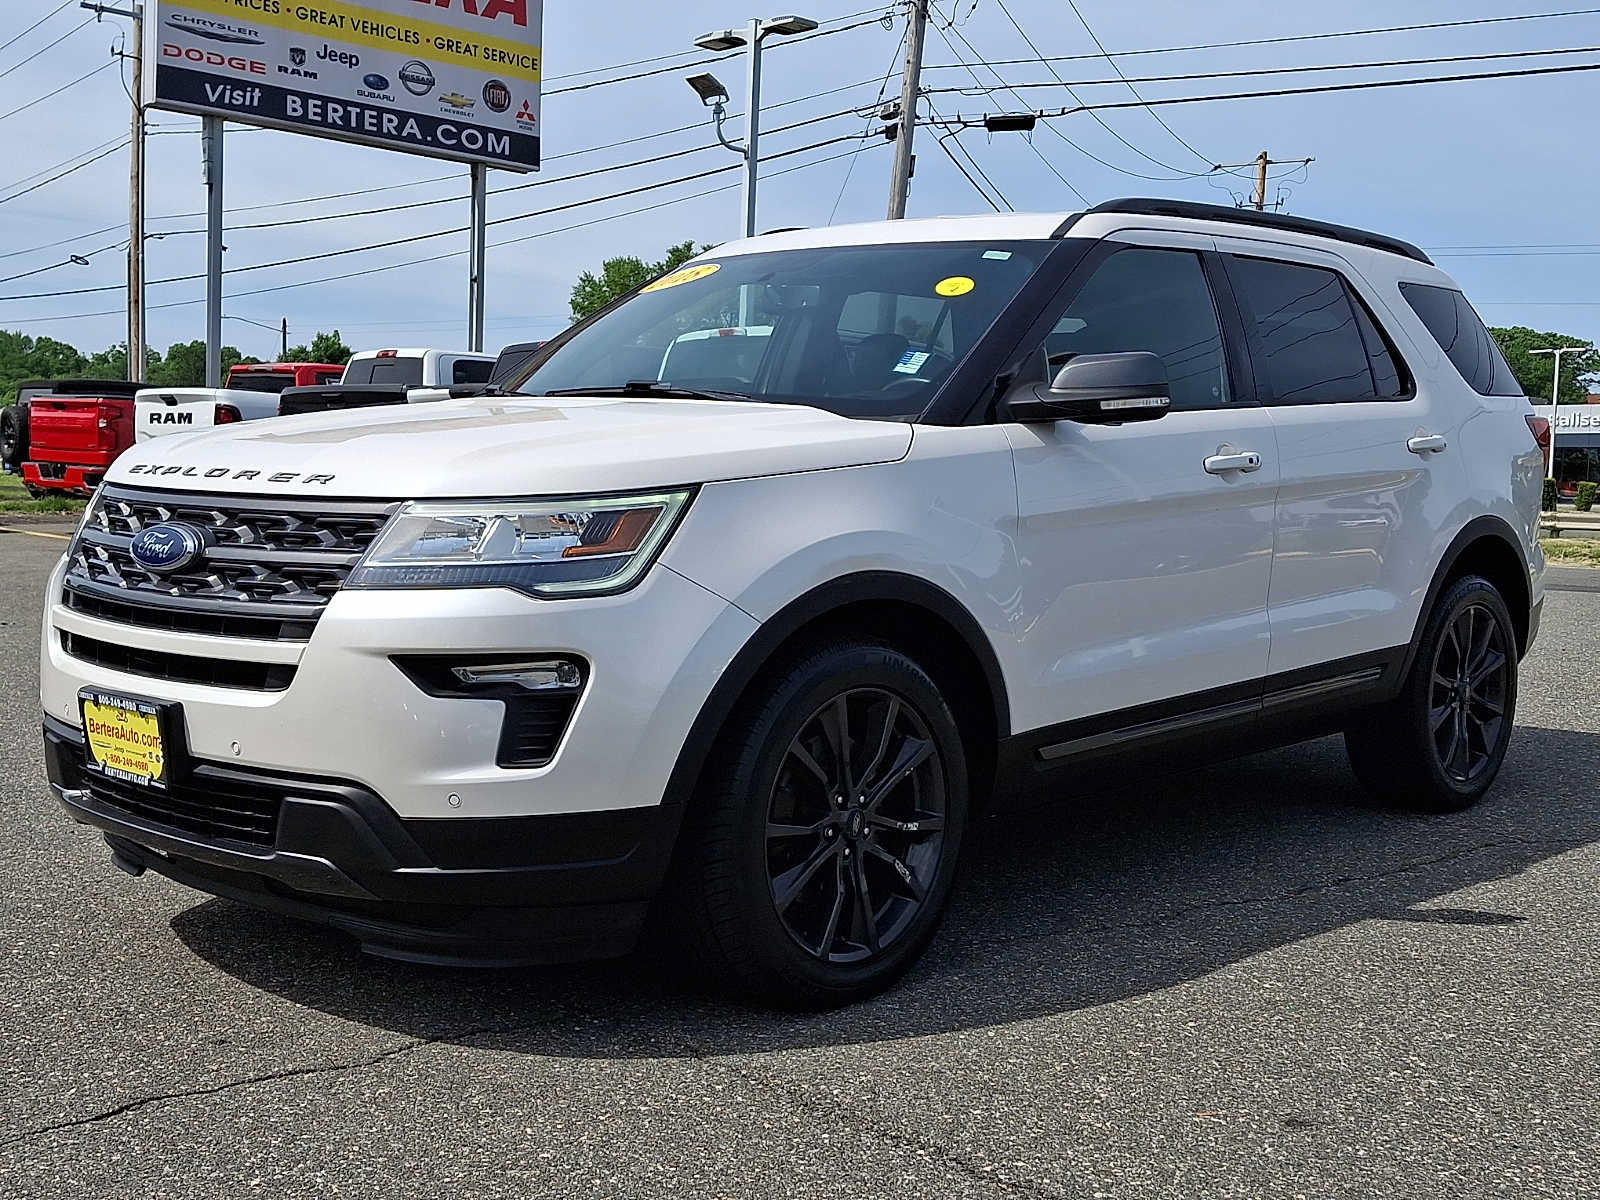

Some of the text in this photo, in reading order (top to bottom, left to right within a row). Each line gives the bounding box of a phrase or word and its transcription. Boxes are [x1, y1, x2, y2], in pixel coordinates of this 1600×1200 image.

[171, 13, 259, 37] CHRYSLER
[295, 6, 345, 29] GREAT
[350, 17, 420, 45] VEHICLES
[433, 36, 479, 58] GREAT
[483, 47, 539, 71] SERVICE
[162, 43, 267, 75] DODGE
[316, 44, 360, 69] Jeep
[277, 64, 318, 80] RAM
[356, 89, 396, 103] SUBARU
[489, 88, 506, 105] FIAT
[204, 82, 511, 156] Visit BERTERA.COM
[149, 412, 193, 425] RAM
[128, 464, 336, 485] EXPLORER
[138, 532, 174, 556] Ford
[88, 718, 161, 749] BerteraAuto.com
